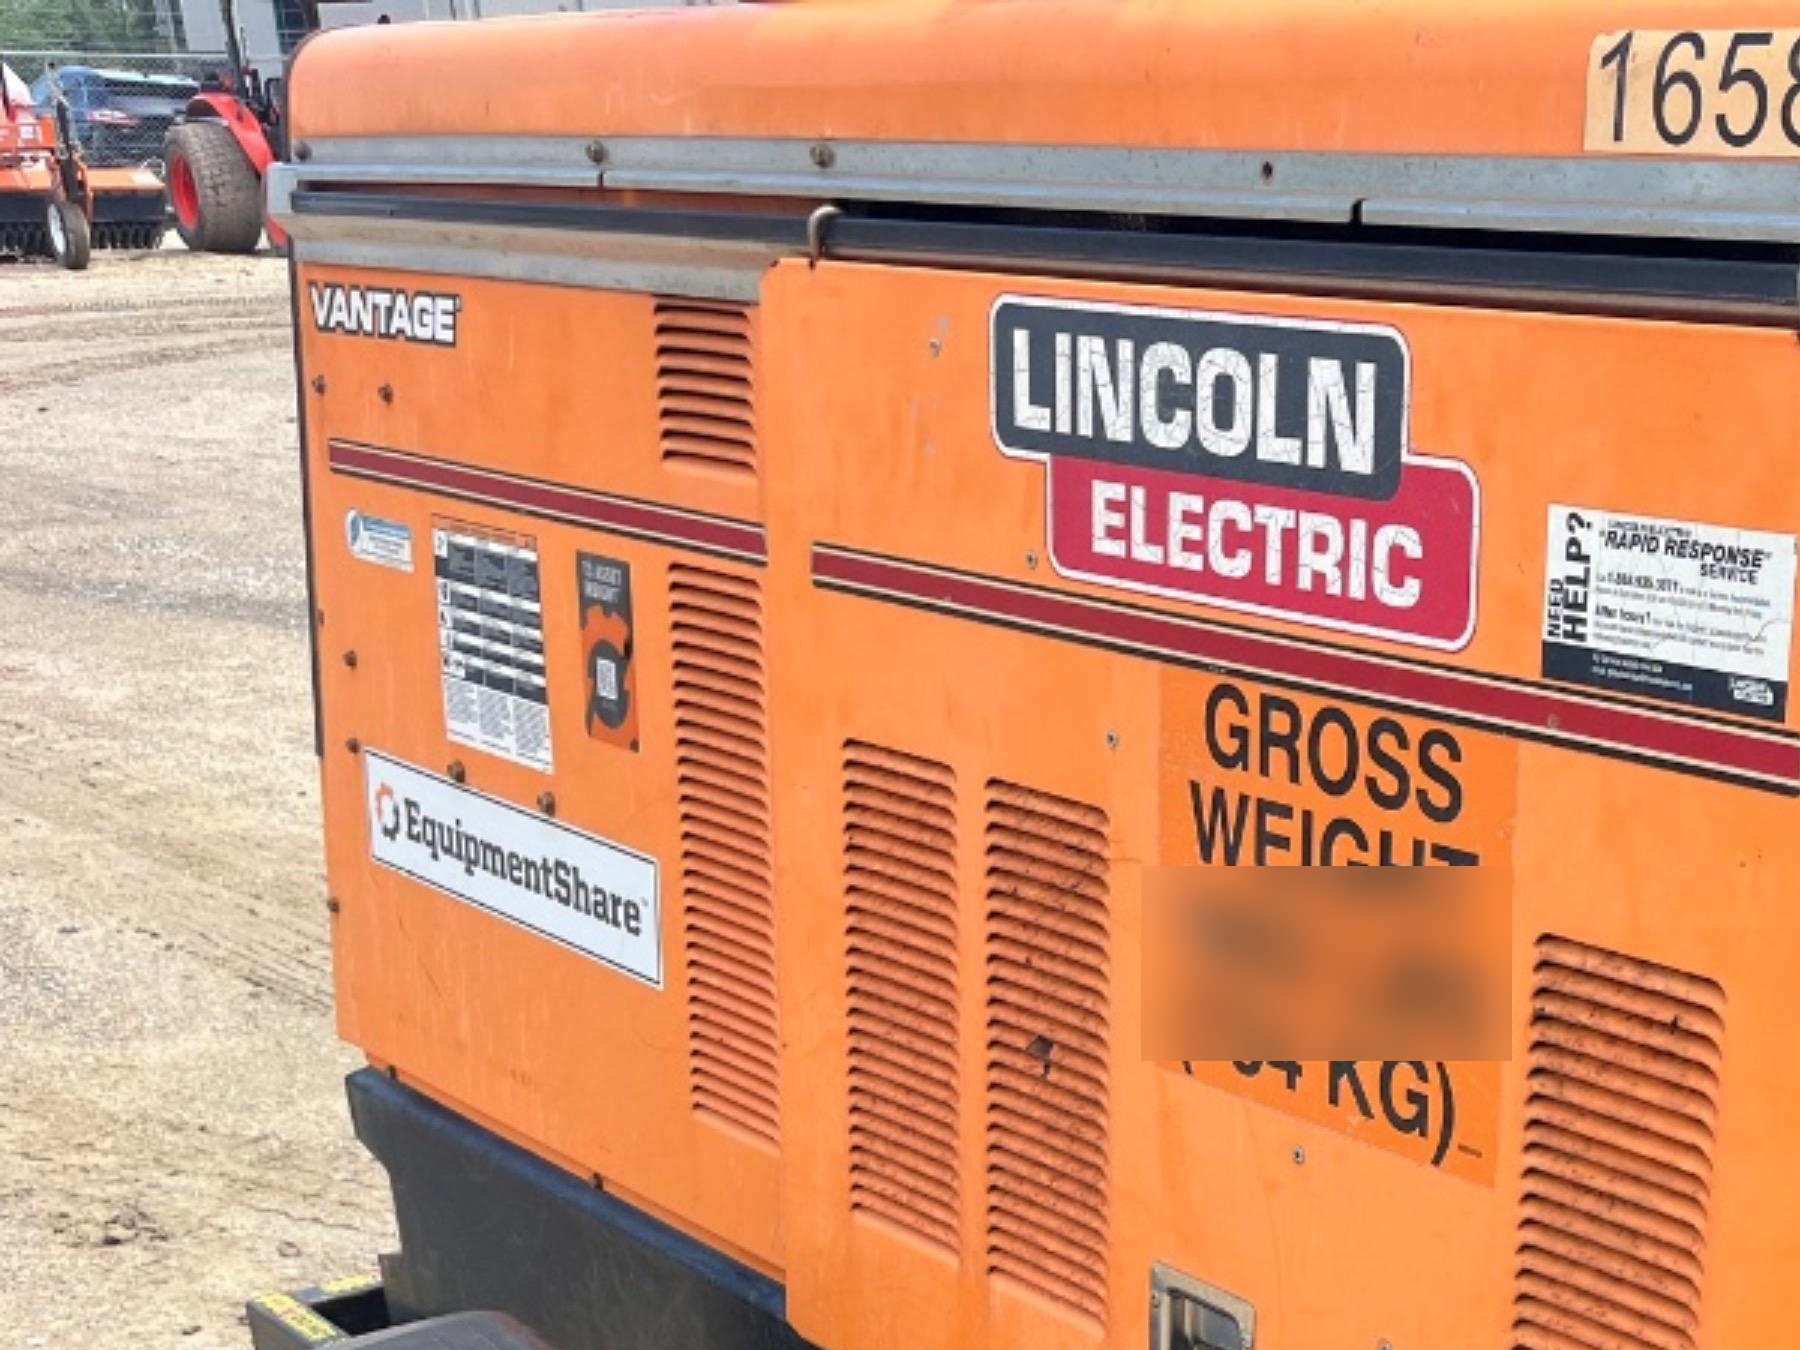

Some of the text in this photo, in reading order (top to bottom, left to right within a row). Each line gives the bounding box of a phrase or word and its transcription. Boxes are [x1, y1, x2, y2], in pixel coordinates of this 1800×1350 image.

[309, 283, 457, 347] VANTAGE
[1012, 328, 1377, 476] LINCOLN
[1090, 479, 1424, 609] ELECTRIC
[1547, 578, 1563, 638] NEED
[1562, 512, 1592, 642] HELP?
[1204, 682, 1463, 824] GROSS
[404, 797, 643, 937] EquipmentShare
